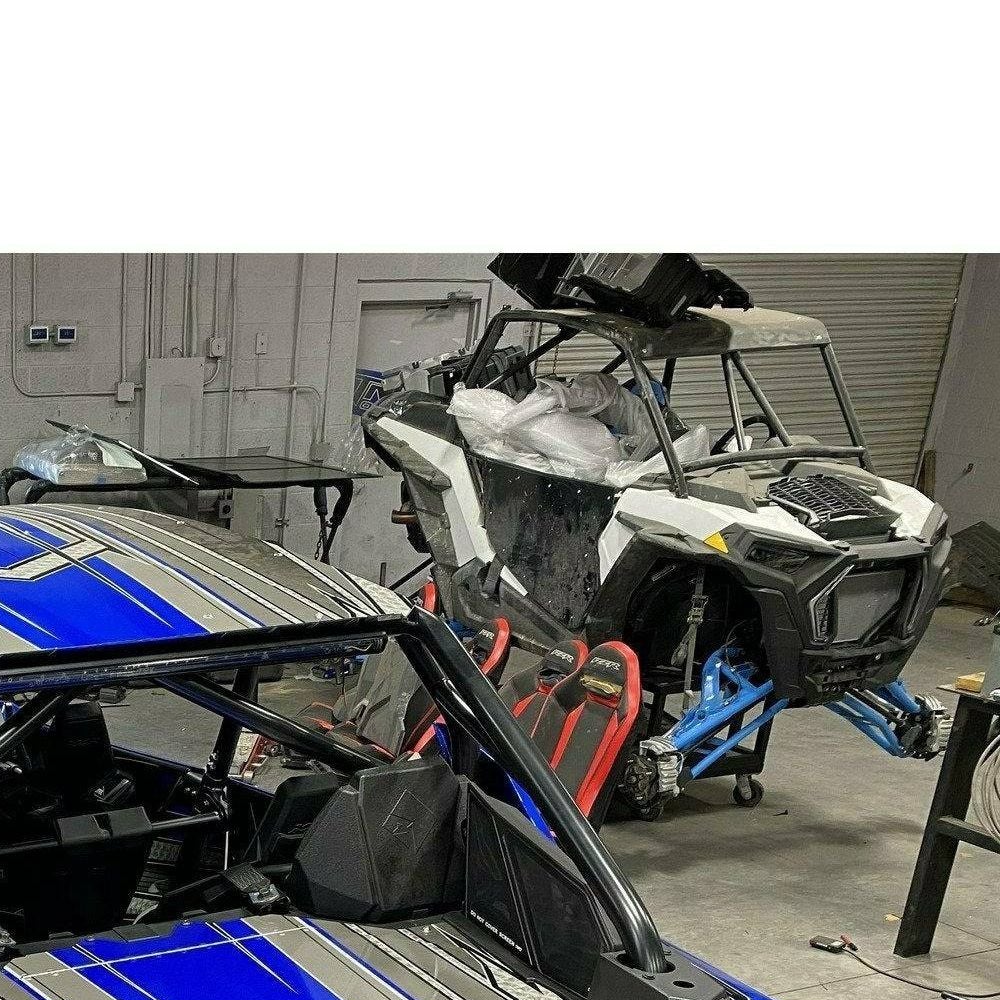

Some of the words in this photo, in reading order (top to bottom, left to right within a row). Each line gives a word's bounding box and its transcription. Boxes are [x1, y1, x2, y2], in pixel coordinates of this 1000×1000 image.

[476, 915, 485, 924] NOT
[484, 921, 499, 935] COVER
[498, 931, 515, 947] SCREEN
